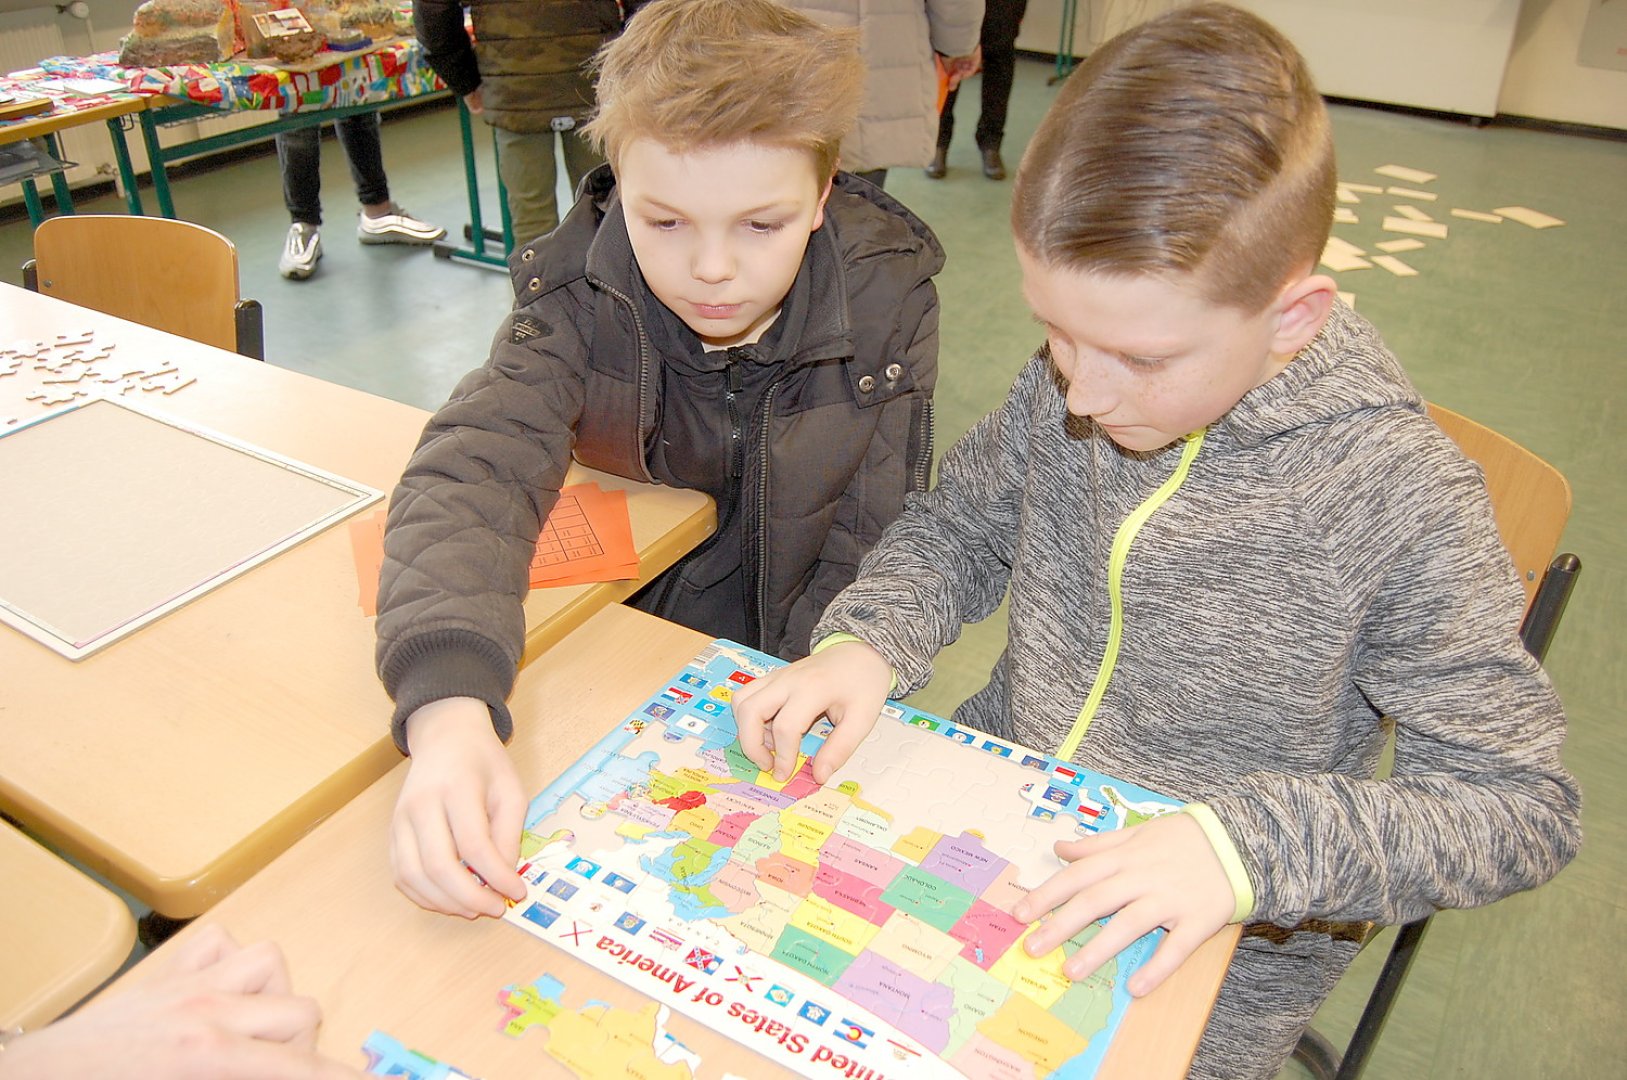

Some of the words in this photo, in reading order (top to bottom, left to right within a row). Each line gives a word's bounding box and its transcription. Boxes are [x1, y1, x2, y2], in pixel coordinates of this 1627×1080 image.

[748, 785, 779, 802] TENNESSEE
[725, 795, 755, 811] KENTUCKY
[688, 820, 704, 830] OHIO
[949, 844, 974, 858] MEXICO
[973, 854, 988, 863] NEW
[853, 857, 878, 871] KANSAS
[766, 872, 783, 883] IOWA
[805, 920, 831, 935] DAKOTA
[987, 921, 1006, 933] UTAH
[781, 949, 808, 965] DAKOTA
[900, 942, 932, 960] WYOMING
[594, 933, 695, 992] America
[806, 960, 830, 975] NORTH
[877, 980, 910, 999] MONTANA
[1019, 975, 1048, 991] NEVADA
[689, 984, 724, 1008] of
[962, 1002, 985, 1017] IDAHO
[725, 999, 810, 1056] States
[1016, 1027, 1049, 1045] OREGON
[973, 1047, 1021, 1072] WASHINGTON
